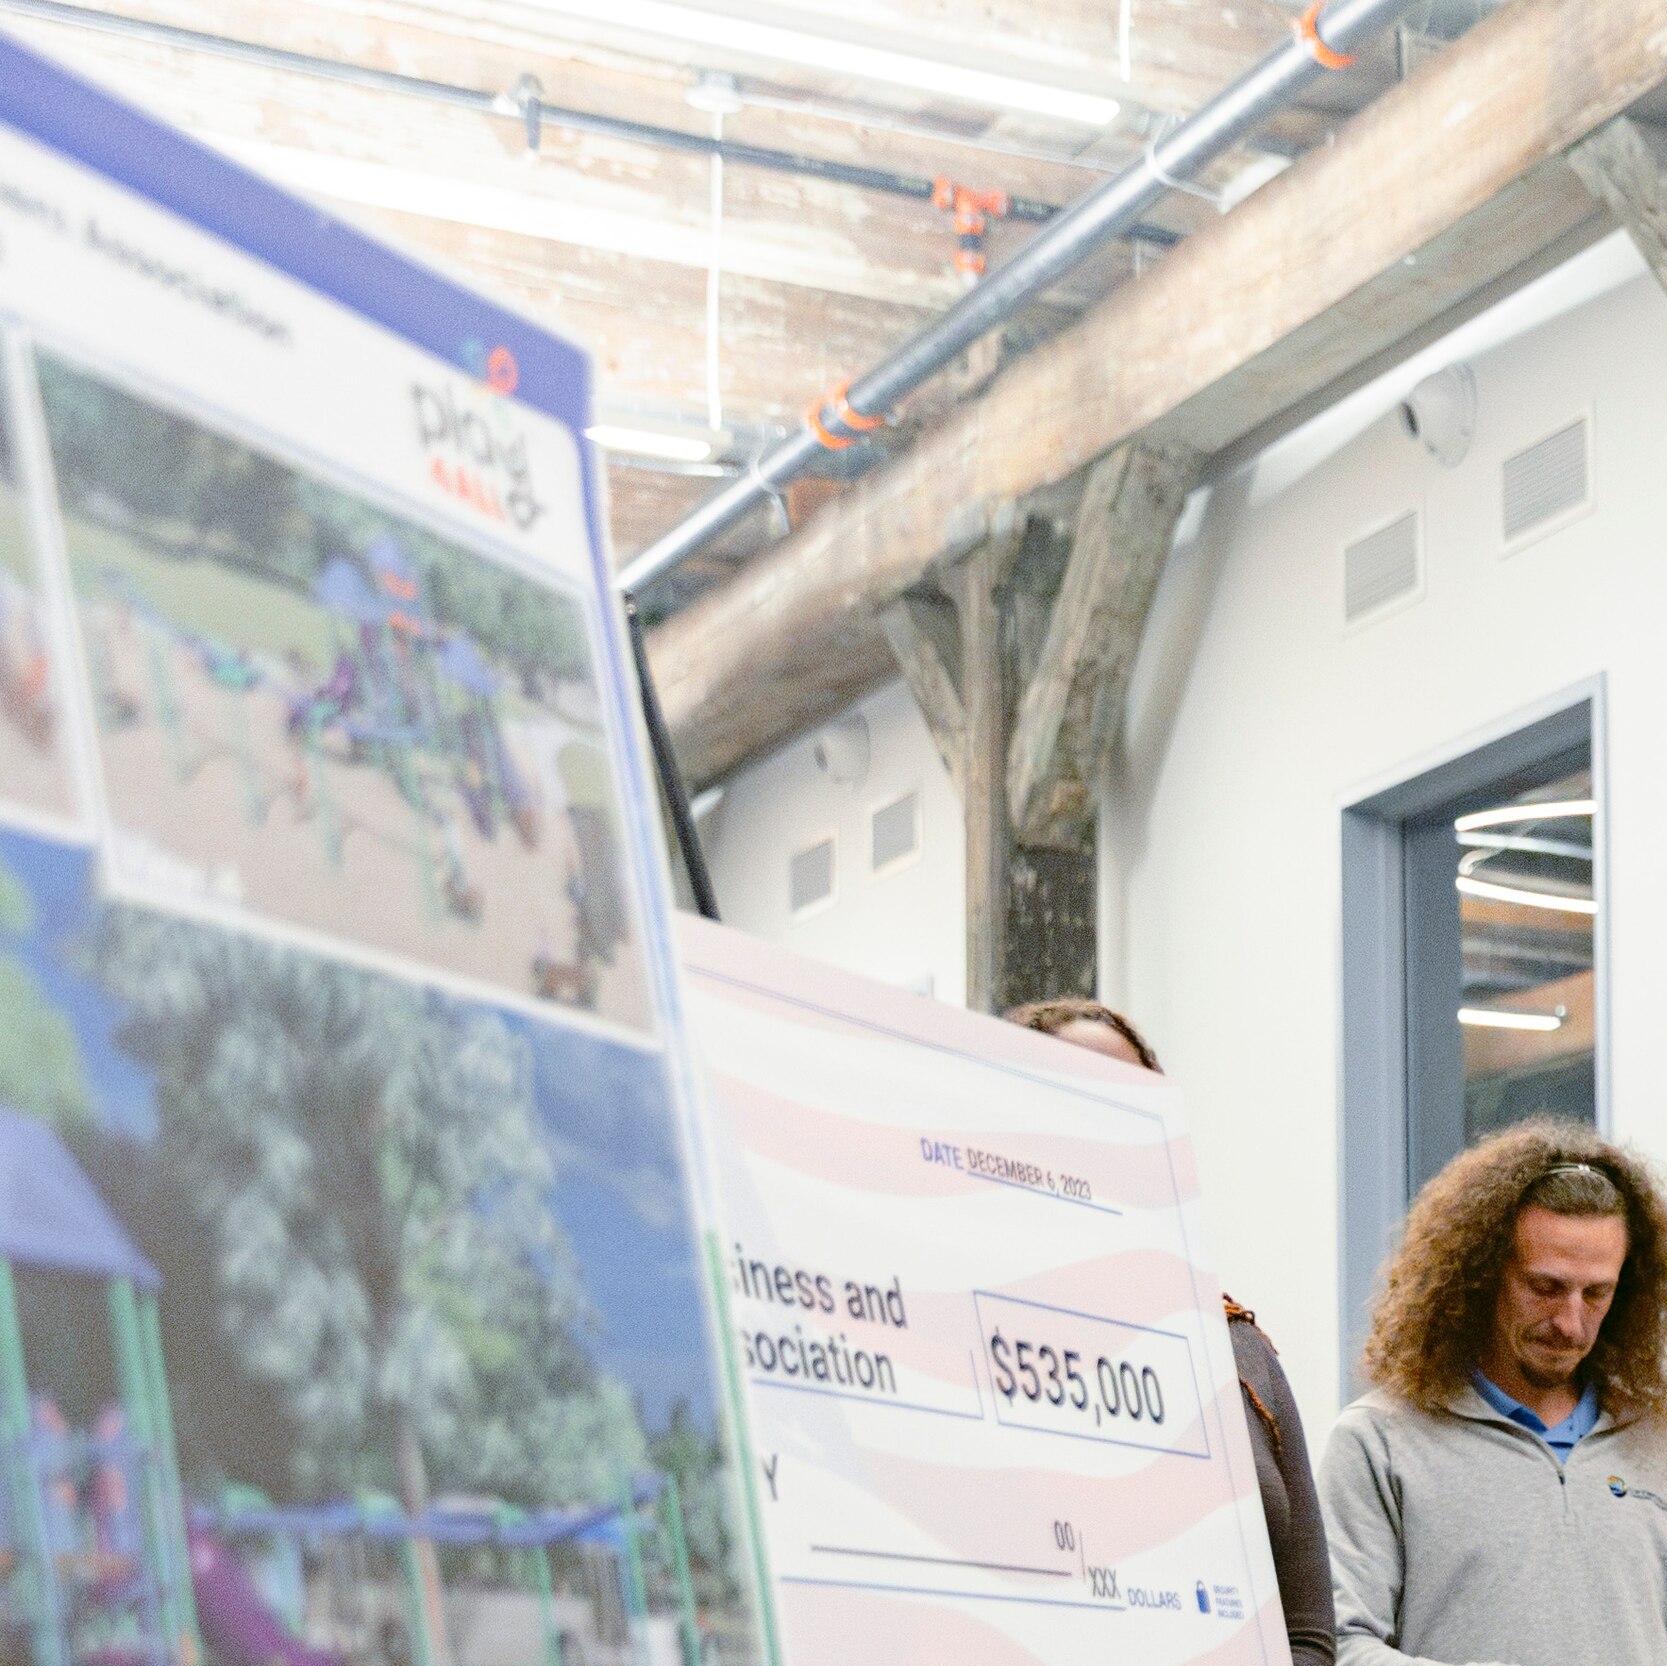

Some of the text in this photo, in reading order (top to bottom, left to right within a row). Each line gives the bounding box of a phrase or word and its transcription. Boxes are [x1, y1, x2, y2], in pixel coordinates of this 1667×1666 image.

[921, 1136, 1093, 1201] DATE DECEMBER 6, 2023
[731, 1242, 910, 1330] iness and
[990, 1325, 1165, 1428] $535,000
[1127, 1588, 1183, 1612] DOLLARS
